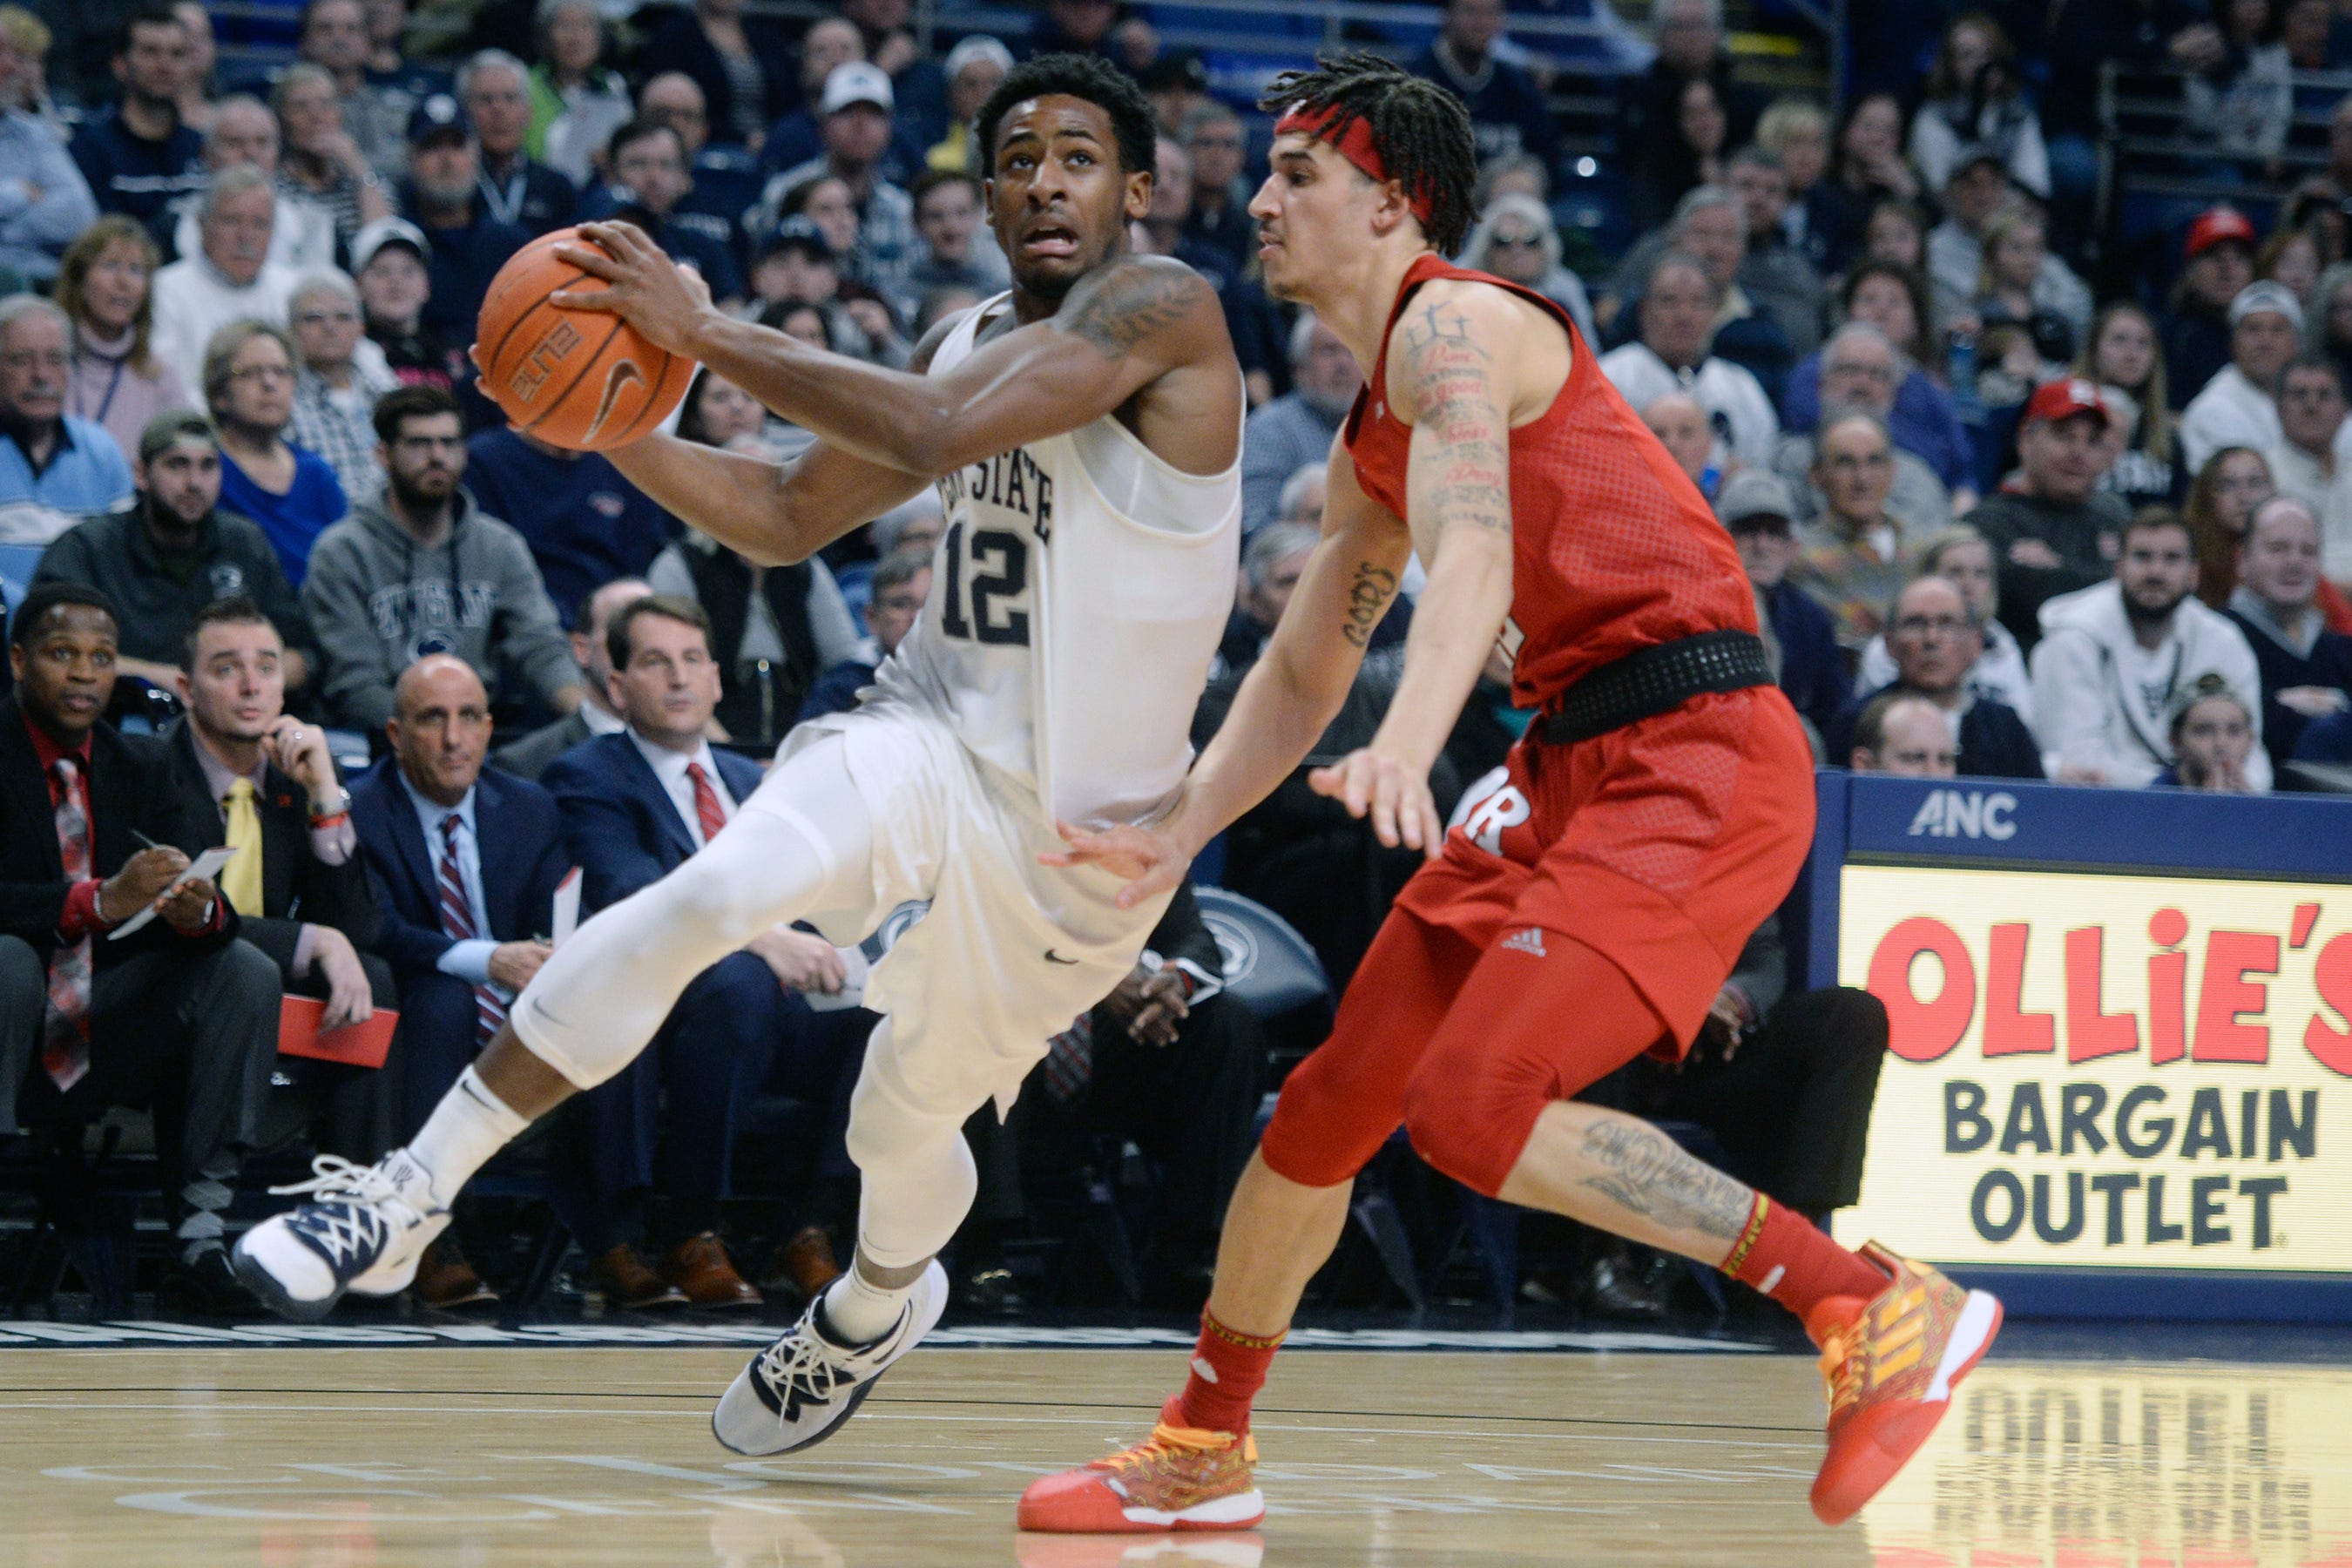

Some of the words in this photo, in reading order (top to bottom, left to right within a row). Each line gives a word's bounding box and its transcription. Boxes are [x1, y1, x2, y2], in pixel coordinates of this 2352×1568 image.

[971, 445, 1053, 548] STATE
[942, 522, 1031, 647] 12
[1907, 789, 2018, 841] ANC
[1943, 1079, 2320, 1162] BARGAIN
[1970, 1167, 2288, 1250] OUTLET
